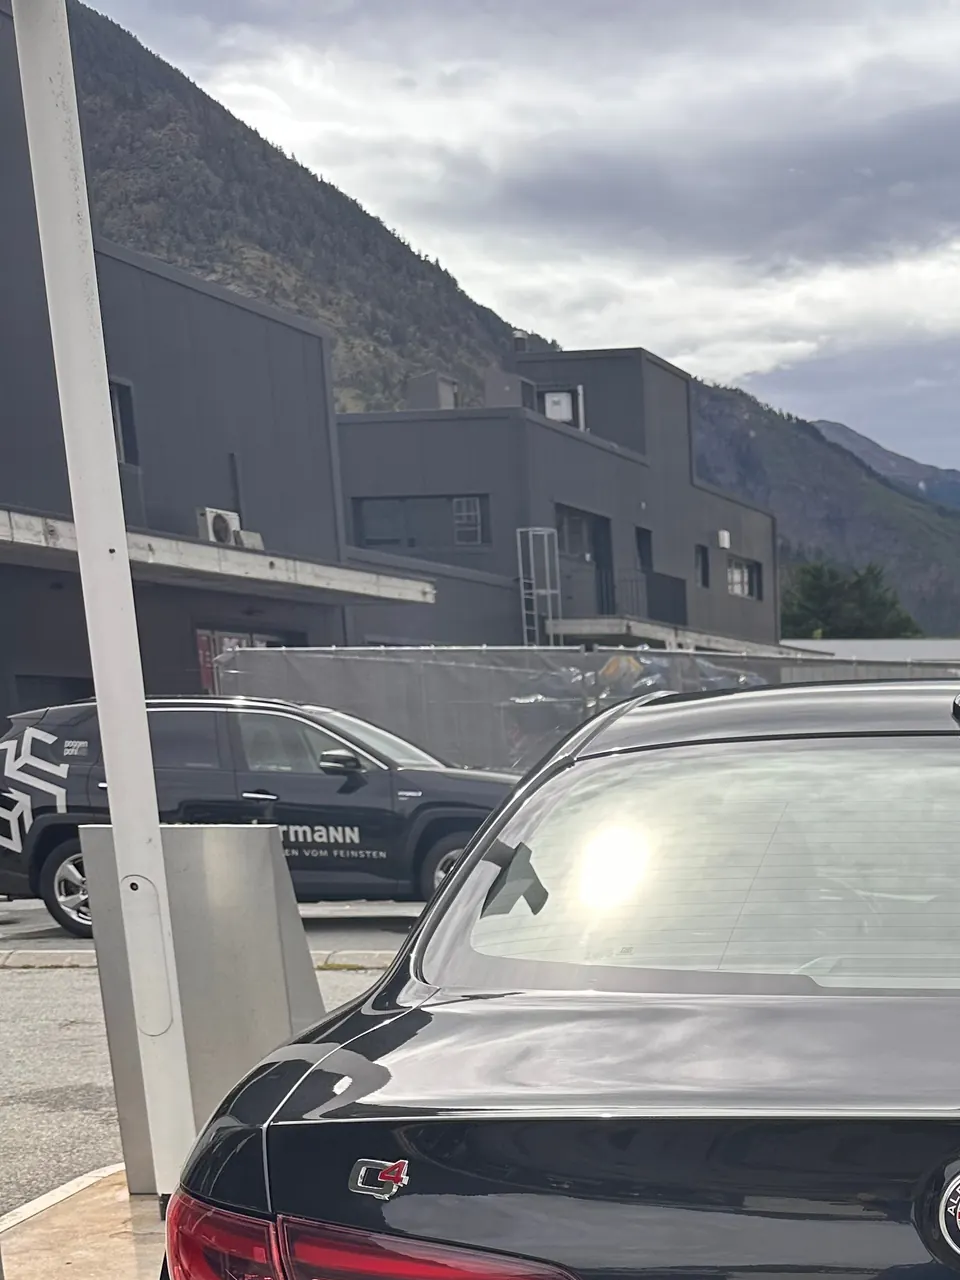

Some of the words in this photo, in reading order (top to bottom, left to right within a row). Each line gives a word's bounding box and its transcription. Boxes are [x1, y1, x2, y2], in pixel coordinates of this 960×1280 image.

[278, 824, 360, 844] rmaNN
[303, 849, 329, 857] VOM
[333, 850, 387, 859] FEINSTEN
[348, 1158, 410, 1201] Q4
